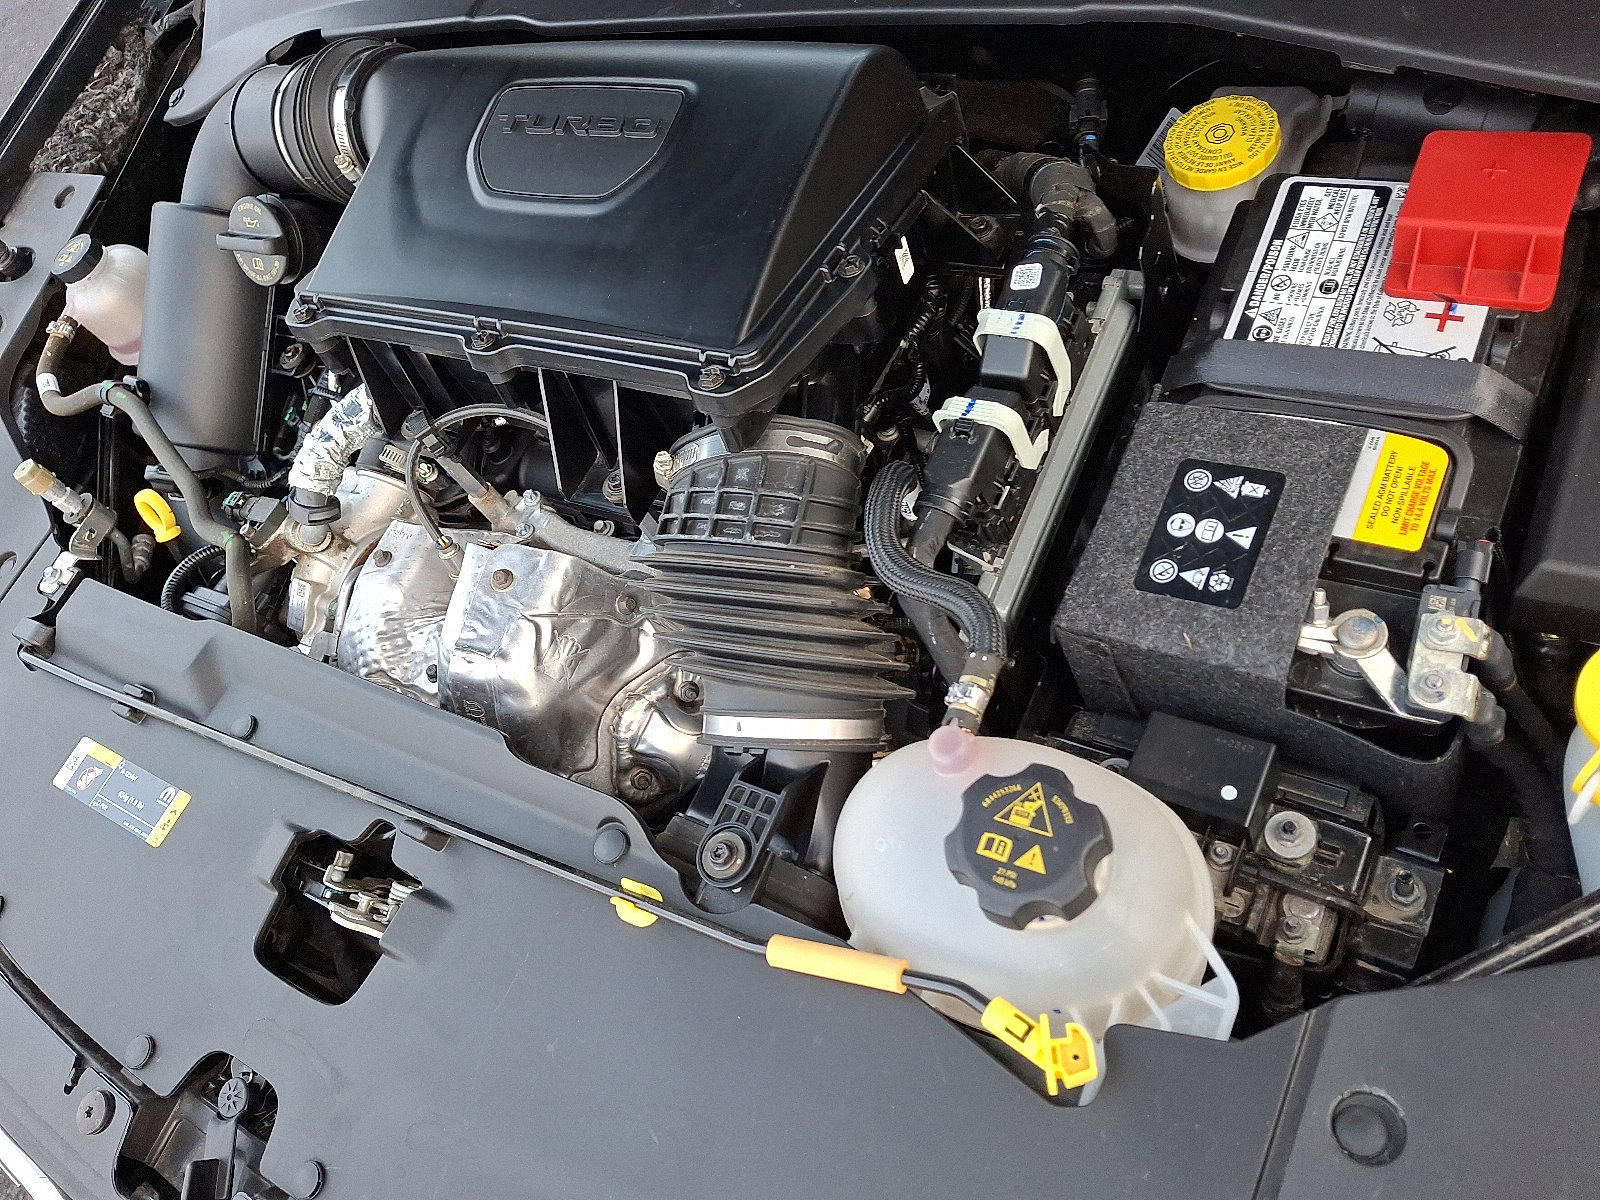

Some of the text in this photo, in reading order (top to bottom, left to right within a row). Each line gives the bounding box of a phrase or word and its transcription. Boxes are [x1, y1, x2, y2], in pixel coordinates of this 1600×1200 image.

[498, 114, 661, 139] TURBO
[1248, 239, 1283, 306] DANGER/POISON
[1366, 450, 1398, 530] SEALED AGM BATTERY
[1381, 505, 1390, 517] DO
[1385, 489, 1396, 505] NOT
[1391, 465, 1417, 525] NON-SPILLABLE
[1398, 460, 1431, 536] LIMIT CHARGE VOLTAGE
[1410, 466, 1438, 532] TO 14.4 VOLTS MAX.
